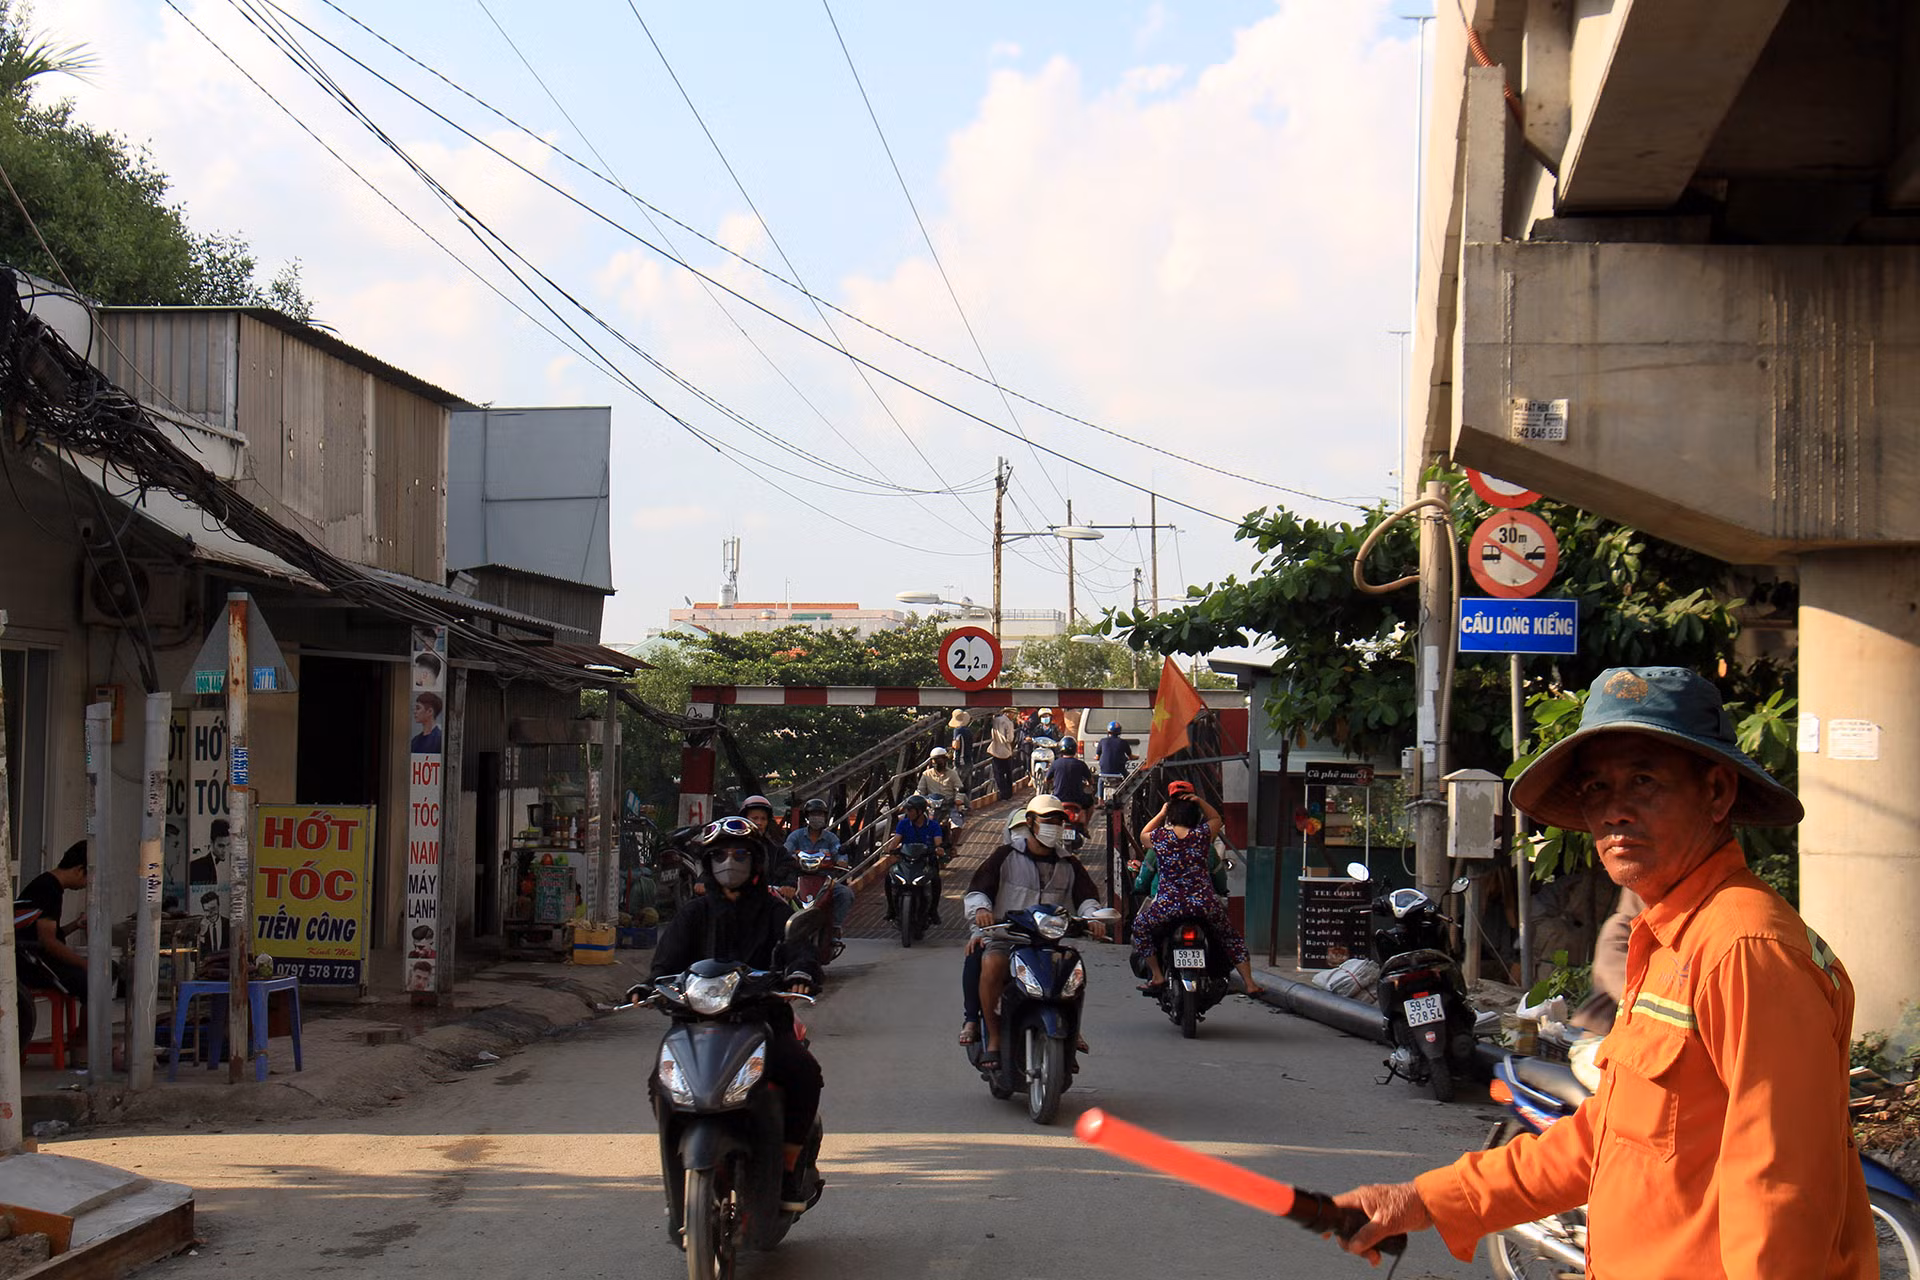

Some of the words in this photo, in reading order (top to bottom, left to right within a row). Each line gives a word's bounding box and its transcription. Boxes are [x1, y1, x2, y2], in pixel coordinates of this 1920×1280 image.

[1531, 427, 1547, 438] 845
[1499, 527, 1527, 543] 30m
[1461, 611, 1494, 634] CẦU
[1496, 616, 1530, 635] LONG
[413, 755, 440, 785] HỚT
[1307, 769, 1319, 778] Cà
[1320, 769, 1340, 780] phê
[413, 797, 439, 827] TÓC
[263, 810, 359, 850] HỚT
[410, 841, 439, 865] NAM
[258, 860, 354, 901] TÓC
[408, 869, 437, 894] MÁY
[408, 899, 436, 923] LẠNH
[257, 905, 301, 939] TIẾN
[306, 911, 356, 942] CÔNG
[277, 963, 305, 977] 0797
[308, 964, 331, 978] 578
[333, 965, 355, 979] 773
[1409, 1008, 1443, 1024] 528.54
[1410, 997, 1437, 1012] 59-G2
